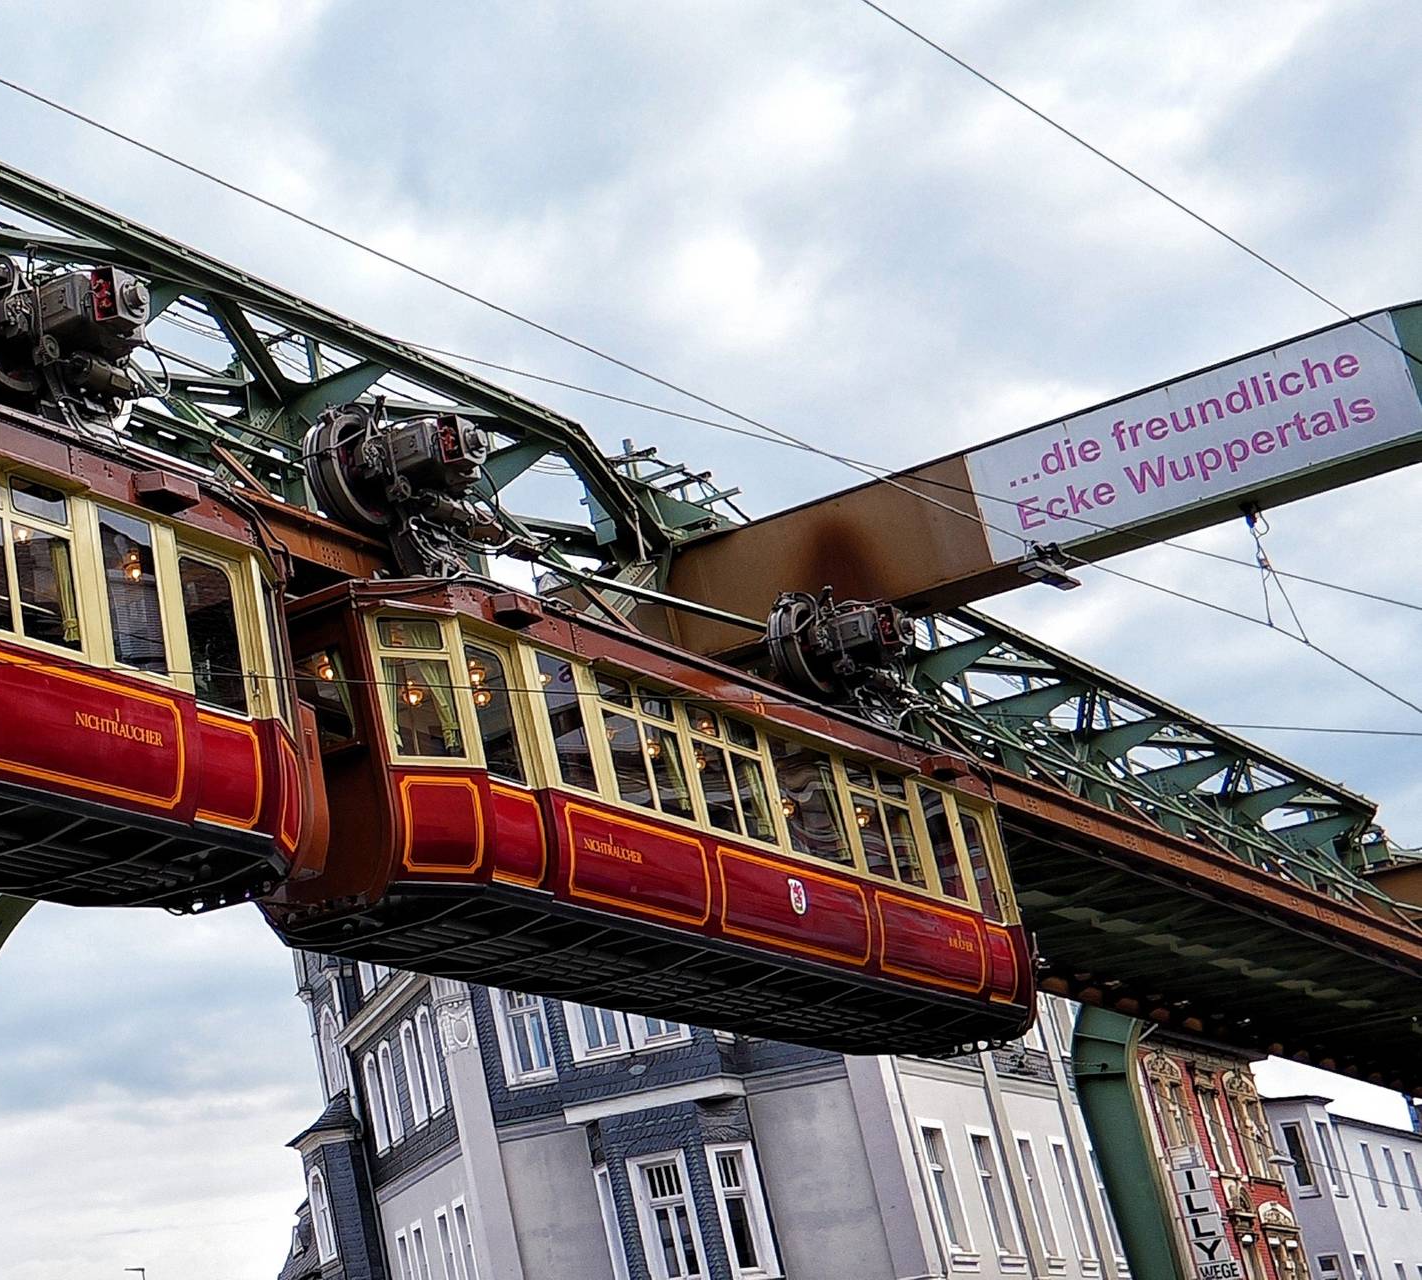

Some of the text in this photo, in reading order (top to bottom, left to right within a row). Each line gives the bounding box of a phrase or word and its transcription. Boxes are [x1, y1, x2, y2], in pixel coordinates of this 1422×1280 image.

[1009, 352, 1360, 488] ...die freundliche
[1017, 398, 1377, 530] Ecke Wuppertals
[75, 711, 164, 747] NICHTRAUCHER
